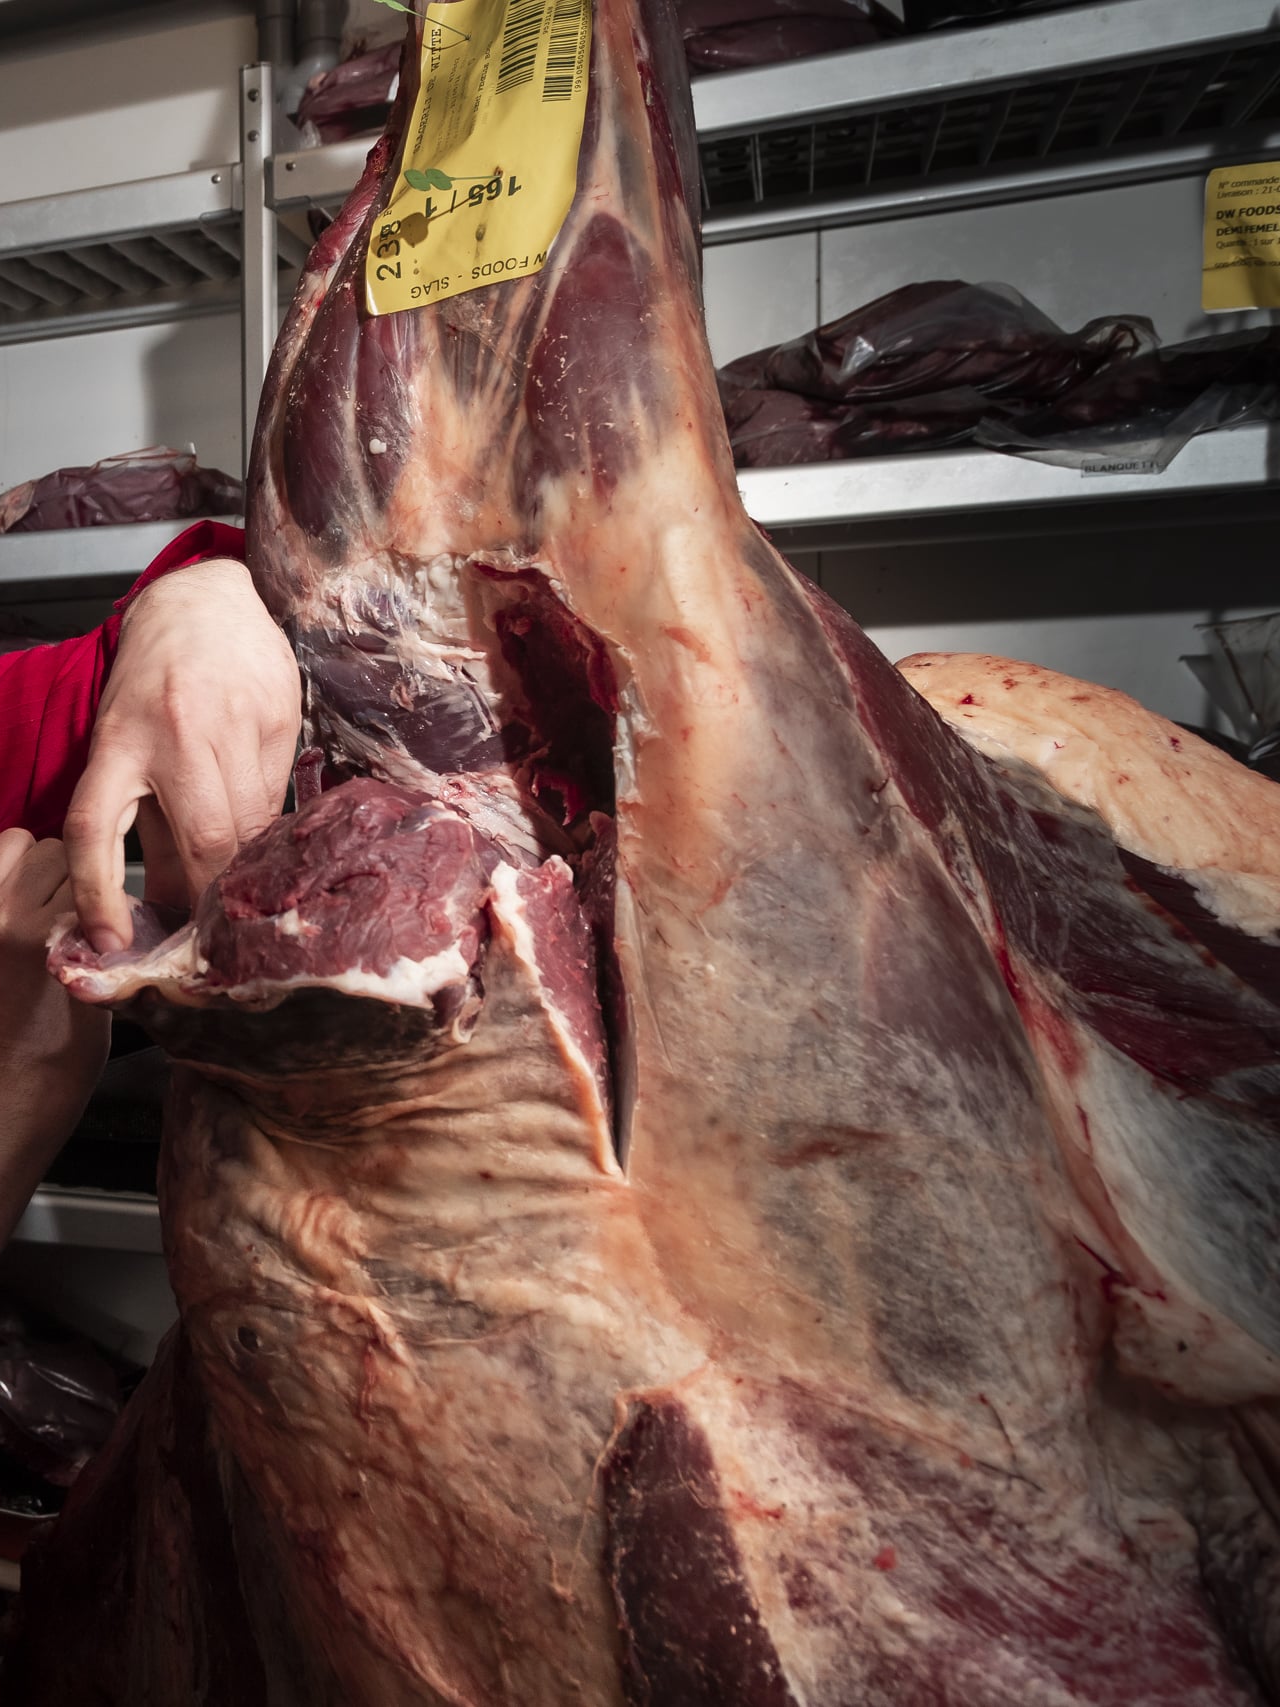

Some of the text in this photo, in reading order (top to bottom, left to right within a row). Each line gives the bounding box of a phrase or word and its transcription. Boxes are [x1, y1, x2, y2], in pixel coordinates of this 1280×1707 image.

[431, 28, 442, 73] WITTE
[1216, 204, 1280, 220] DW FOODS
[1216, 225, 1243, 236] DEMI
[471, 255, 529, 279] FOODS
[410, 276, 450, 299] SLAG
